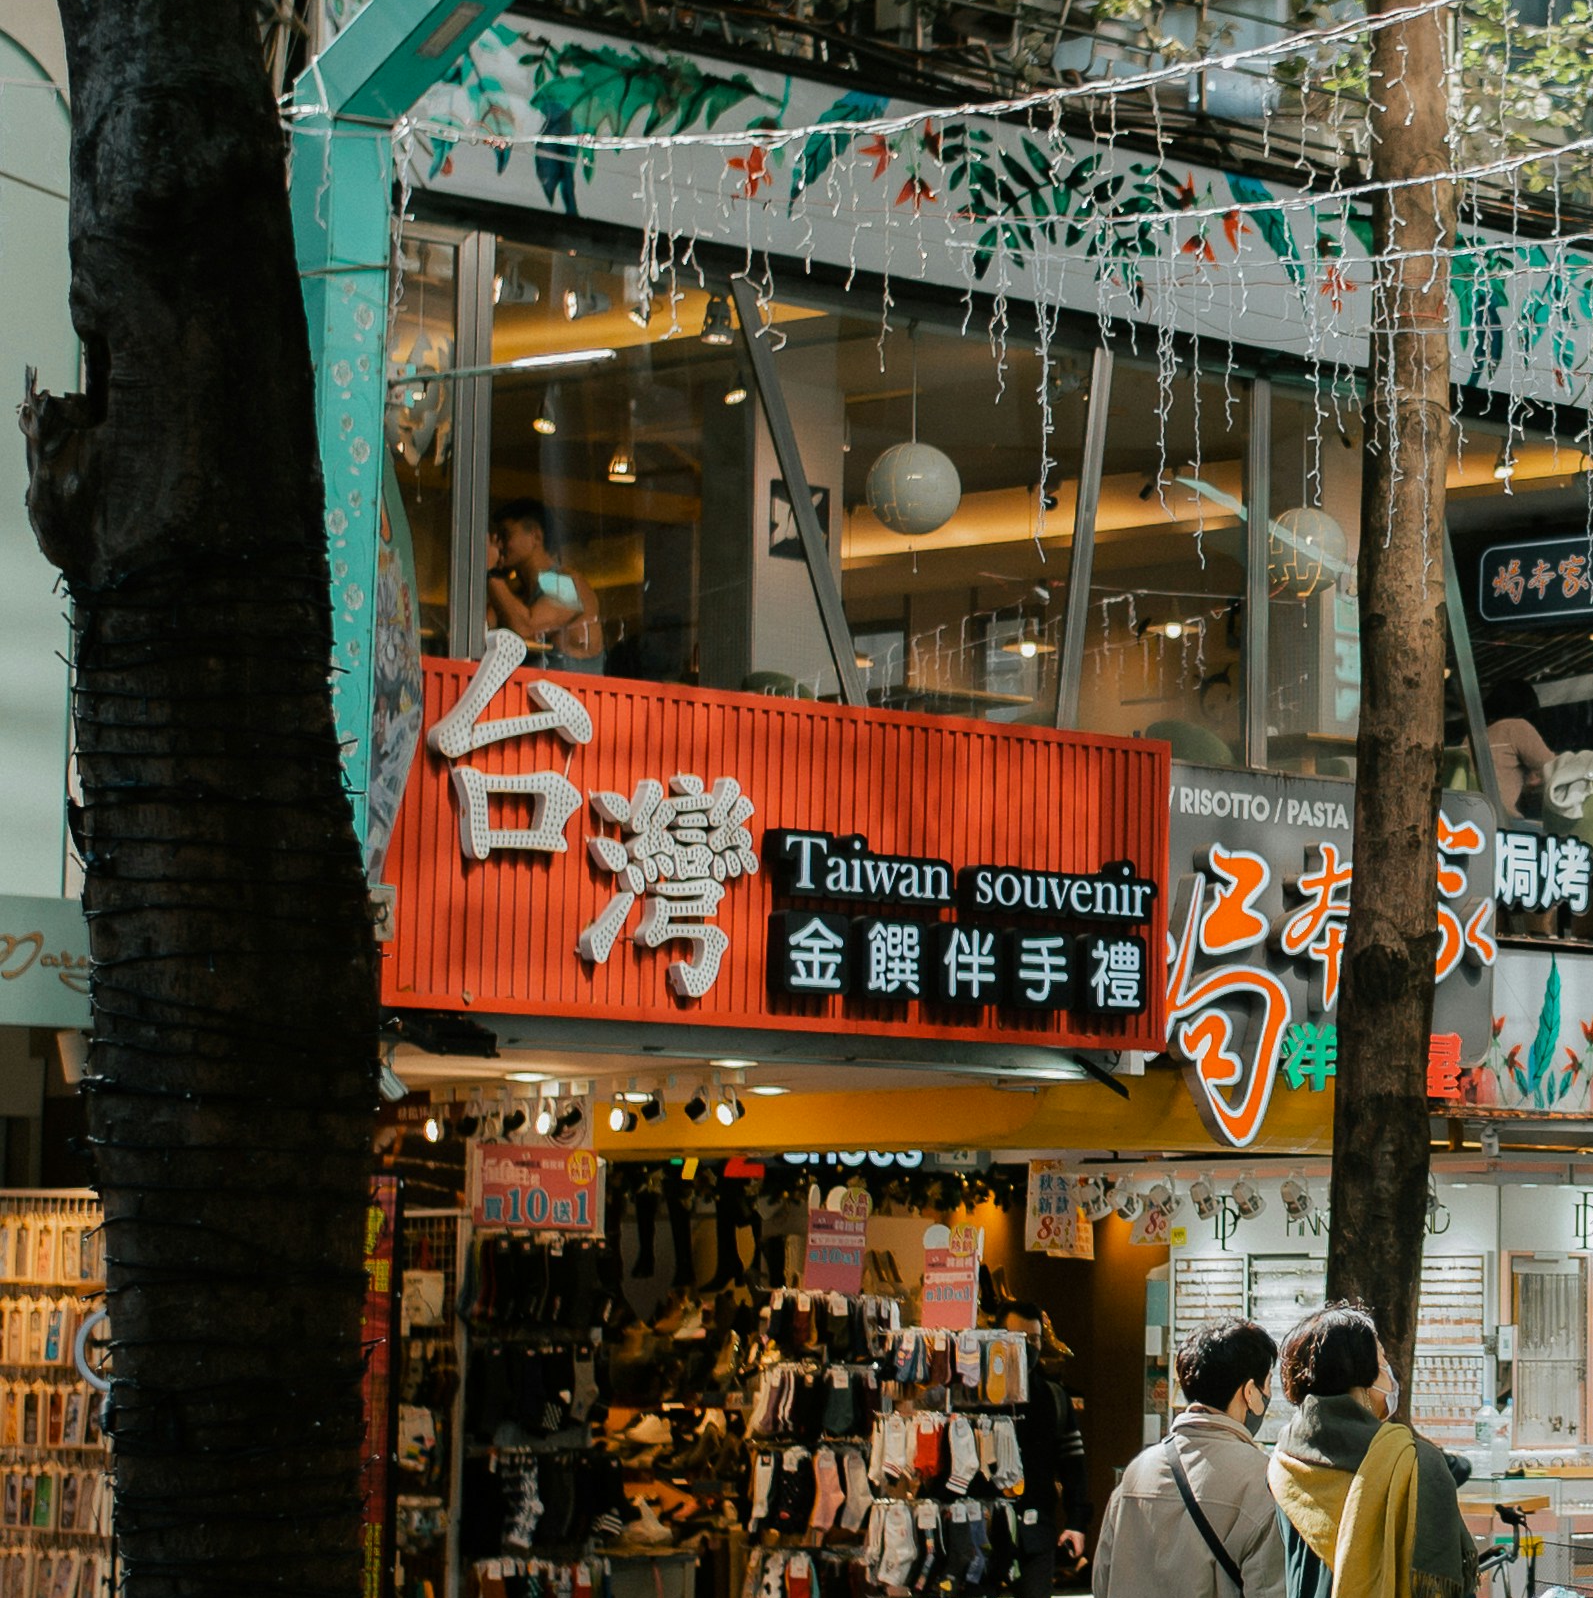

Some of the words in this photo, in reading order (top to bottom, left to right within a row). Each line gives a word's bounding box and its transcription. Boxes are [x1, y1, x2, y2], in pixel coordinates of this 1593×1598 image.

[428, 629, 760, 998] 台灣
[1179, 787, 1269, 823] RISOTTO
[1287, 799, 1349, 830] PASTA
[785, 833, 951, 901] Taiwan
[975, 867, 1153, 918] souvenir
[787, 915, 1143, 1010] 金饌伴手禮
